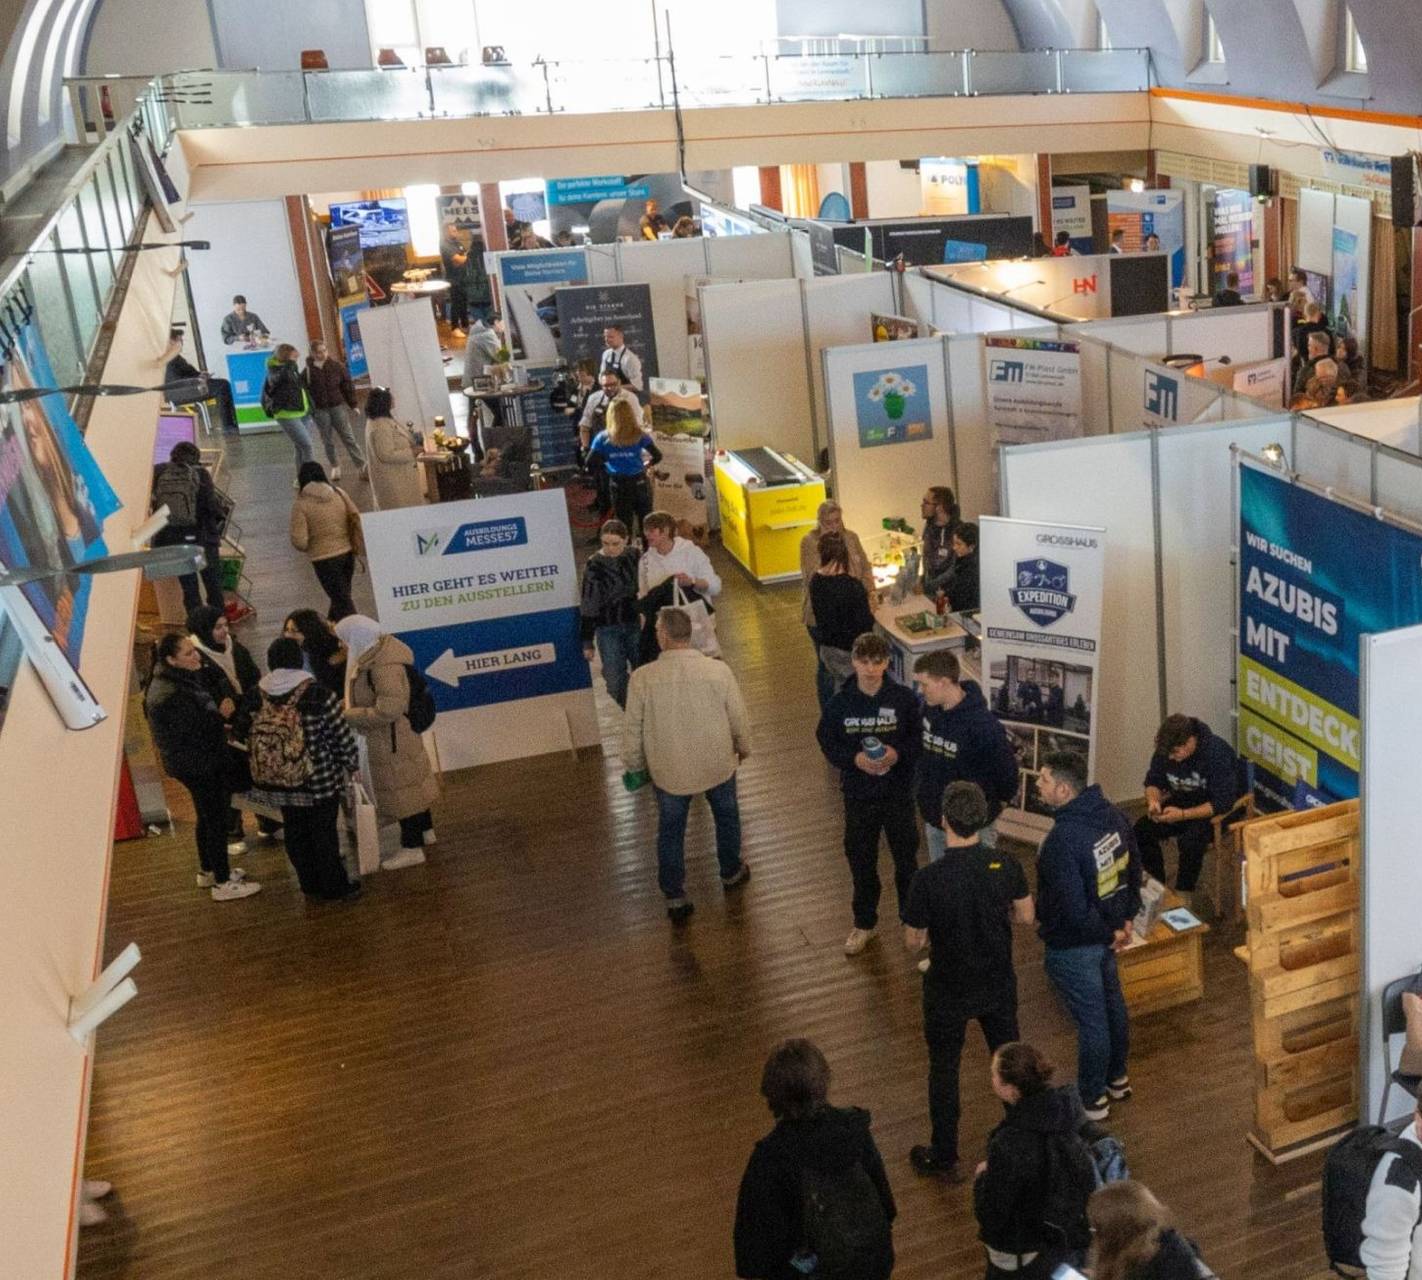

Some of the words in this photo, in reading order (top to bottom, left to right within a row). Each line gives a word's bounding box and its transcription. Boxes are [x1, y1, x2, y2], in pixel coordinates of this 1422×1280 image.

[1246, 531, 1268, 554] WIR
[1269, 543, 1312, 574] SUCHEN
[392, 581, 429, 598] HIER
[433, 576, 475, 592] GEHT
[479, 574, 496, 586] ES
[500, 564, 559, 582] WEITER
[402, 600, 421, 612] ZU
[424, 596, 453, 608] DEN
[457, 581, 555, 603] AUSSTELLERN
[1018, 591, 1069, 607] EXPEDITION
[1246, 565, 1338, 636] AZUBIS
[466, 657, 500, 671] HIER
[504, 649, 542, 665] LANG
[1247, 616, 1290, 663] MIT
[1247, 669, 1360, 761] ENTDECK
[1247, 726, 1312, 784] GEIST
